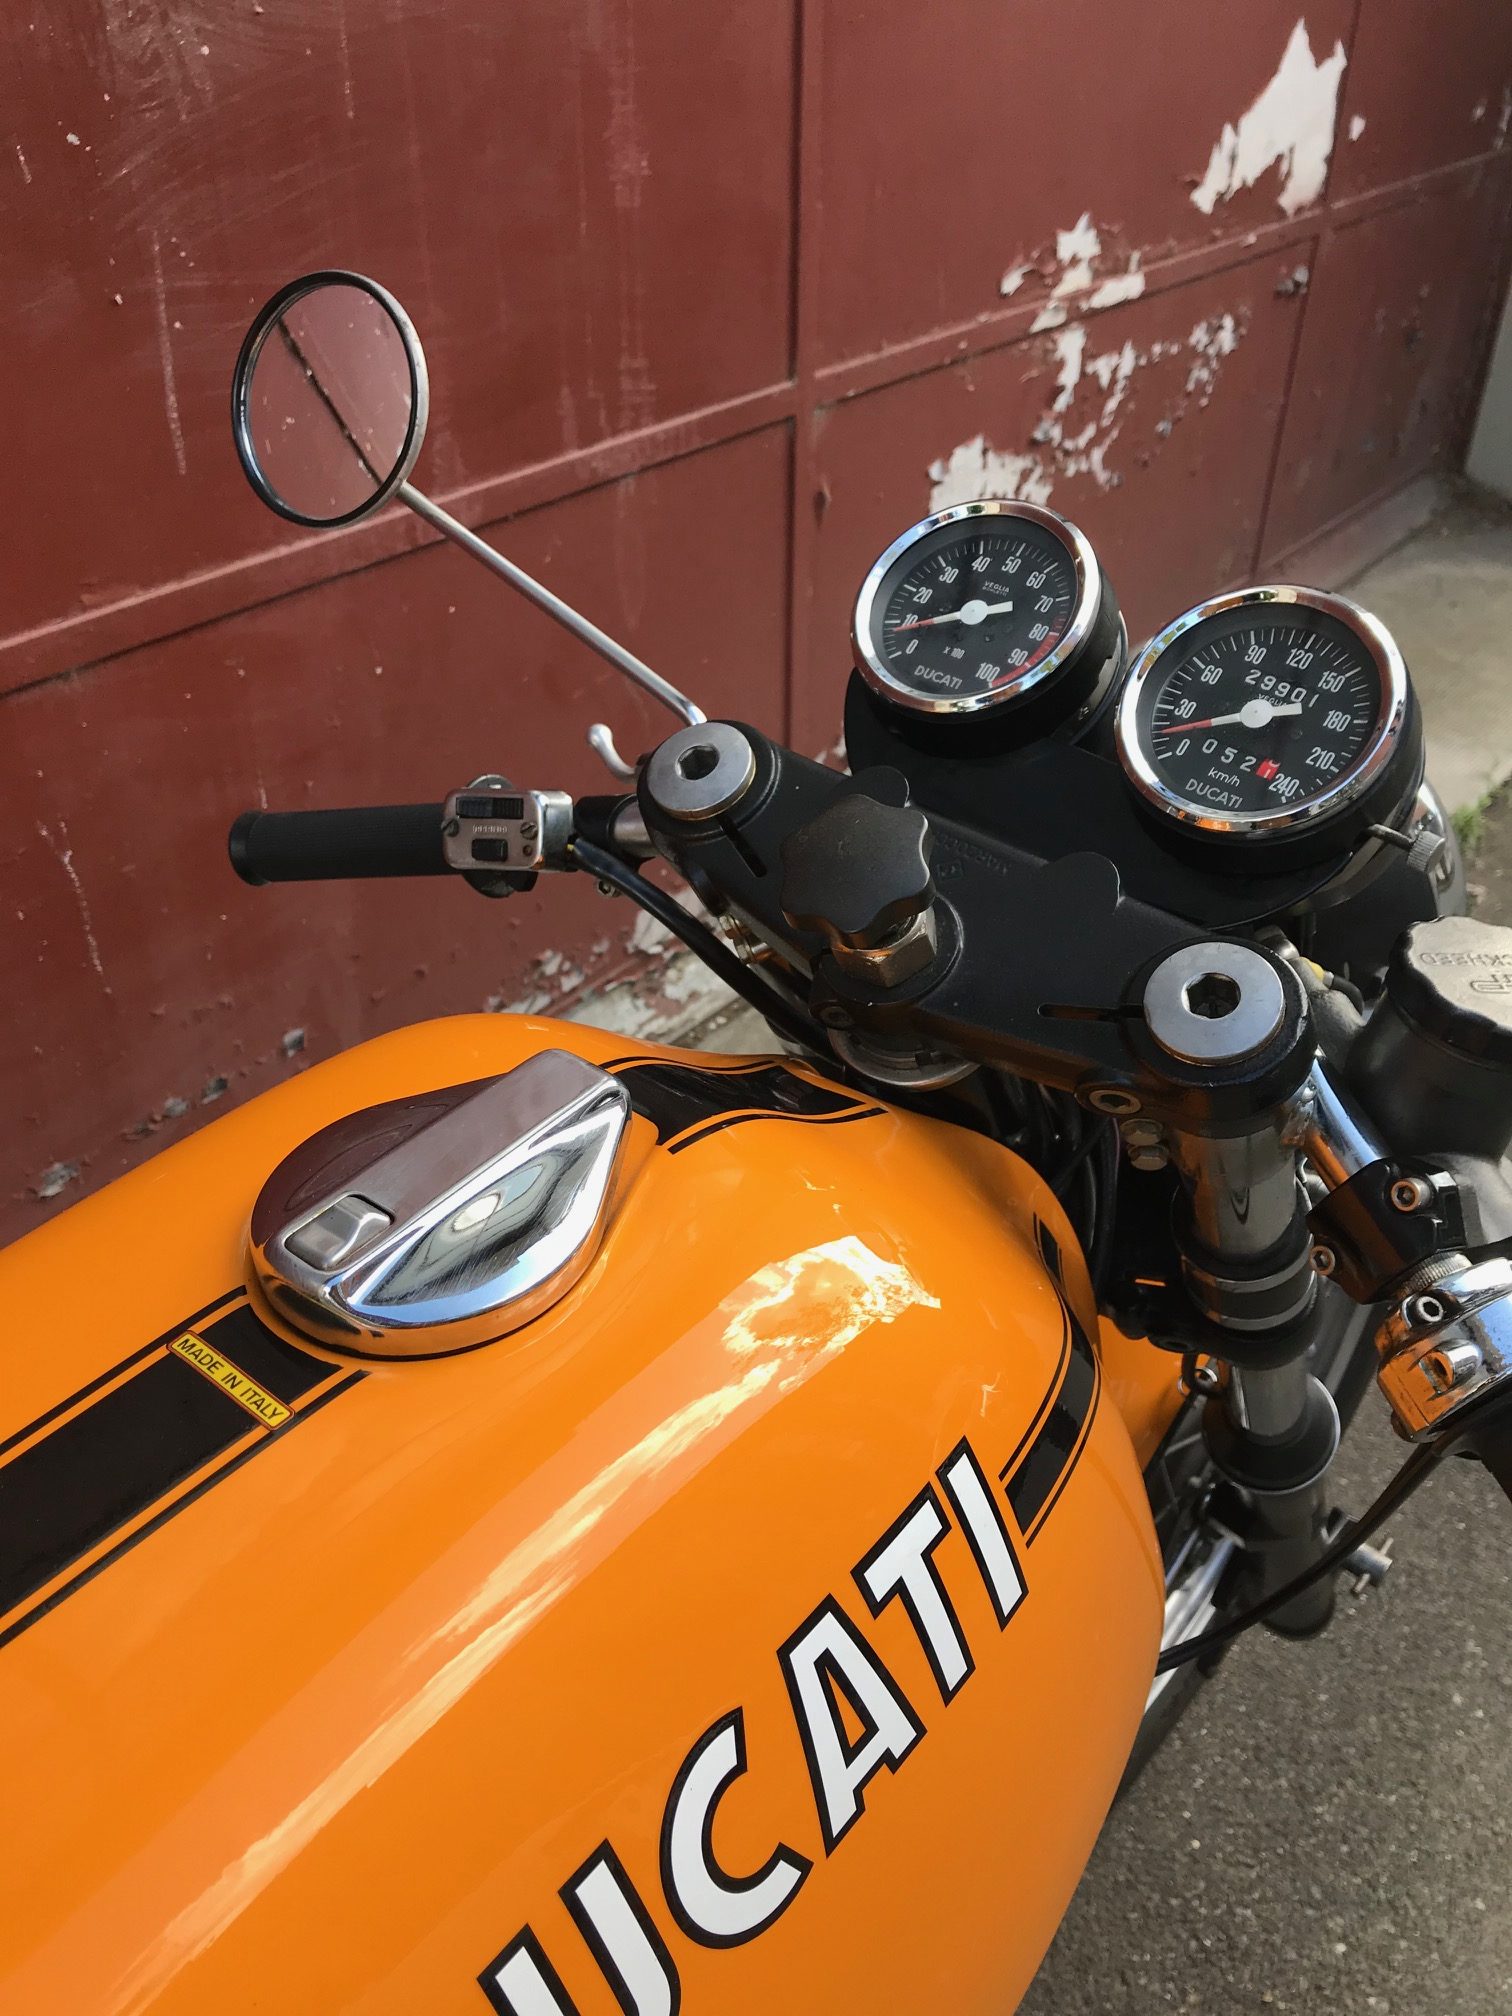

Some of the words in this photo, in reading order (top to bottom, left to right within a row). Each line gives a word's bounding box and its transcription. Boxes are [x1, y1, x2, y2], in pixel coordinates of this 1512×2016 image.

[939, 567, 959, 583] 30
[971, 557, 990, 573] 40
[1002, 557, 1021, 574] 50
[984, 581, 1010, 593] VEGLIA
[1026, 571, 1046, 589] 60
[913, 586, 933, 604] 20
[1034, 595, 1053, 612] 70
[1029, 624, 1049, 641] 80
[905, 639, 919, 655] 0
[1244, 645, 1266, 665] 90
[1008, 649, 1027, 666] 90
[1285, 649, 1313, 670] 120
[914, 664, 963, 690] DUCATI
[975, 662, 1000, 683] 100
[1200, 665, 1223, 685] 60
[1318, 671, 1346, 693] 150
[1174, 699, 1197, 719] 30
[1257, 693, 1289, 706] VEGLI
[1322, 710, 1351, 732] 180
[1175, 739, 1191, 756] 0
[1305, 746, 1336, 770] 210
[1207, 766, 1242, 787] km/h
[1269, 774, 1300, 797] 240
[1185, 778, 1243, 809] DUCATI
[177, 1338, 224, 1375] MADE
[221, 1372, 243, 1390] IN
[240, 1387, 284, 1420] ITALY
